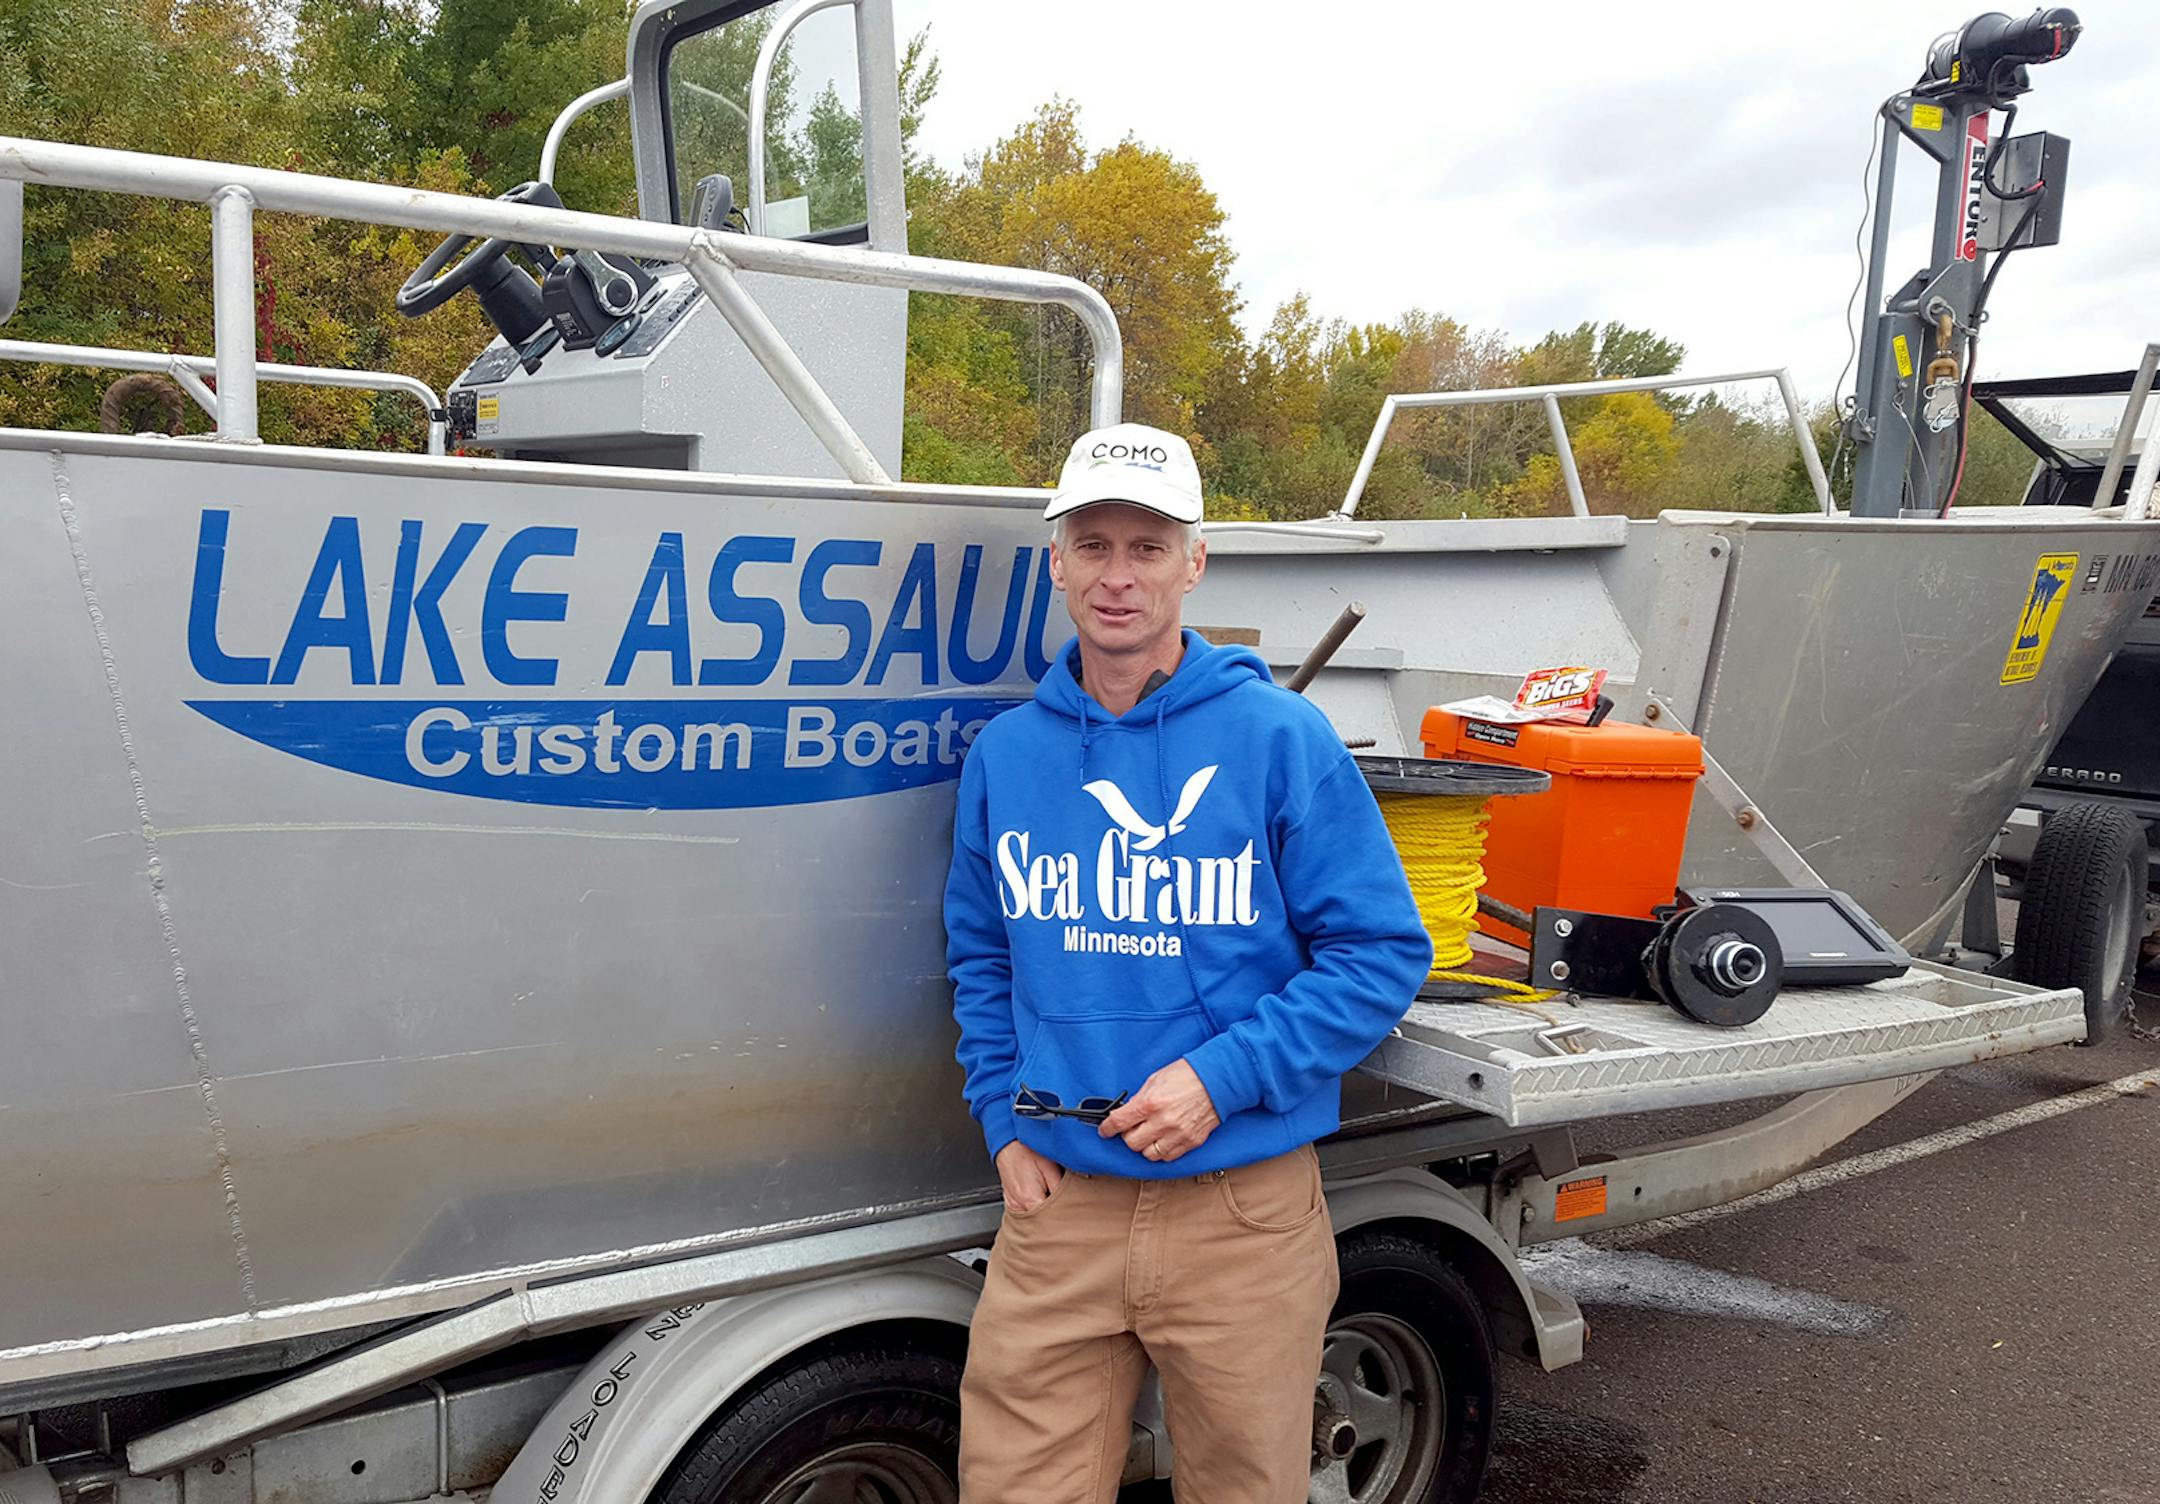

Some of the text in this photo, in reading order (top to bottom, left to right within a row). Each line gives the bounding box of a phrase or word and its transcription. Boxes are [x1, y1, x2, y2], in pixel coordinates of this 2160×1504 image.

[1091, 443, 1168, 463] COMO
[188, 509, 1055, 686] LAKE ASSAUL
[405, 707, 752, 777] Custom
[2043, 766, 2121, 783] ERADO
[997, 828, 1262, 926] Sea Grant
[1064, 926, 1182, 957] Minnesota
[536, 1351, 637, 1504] LOADE
